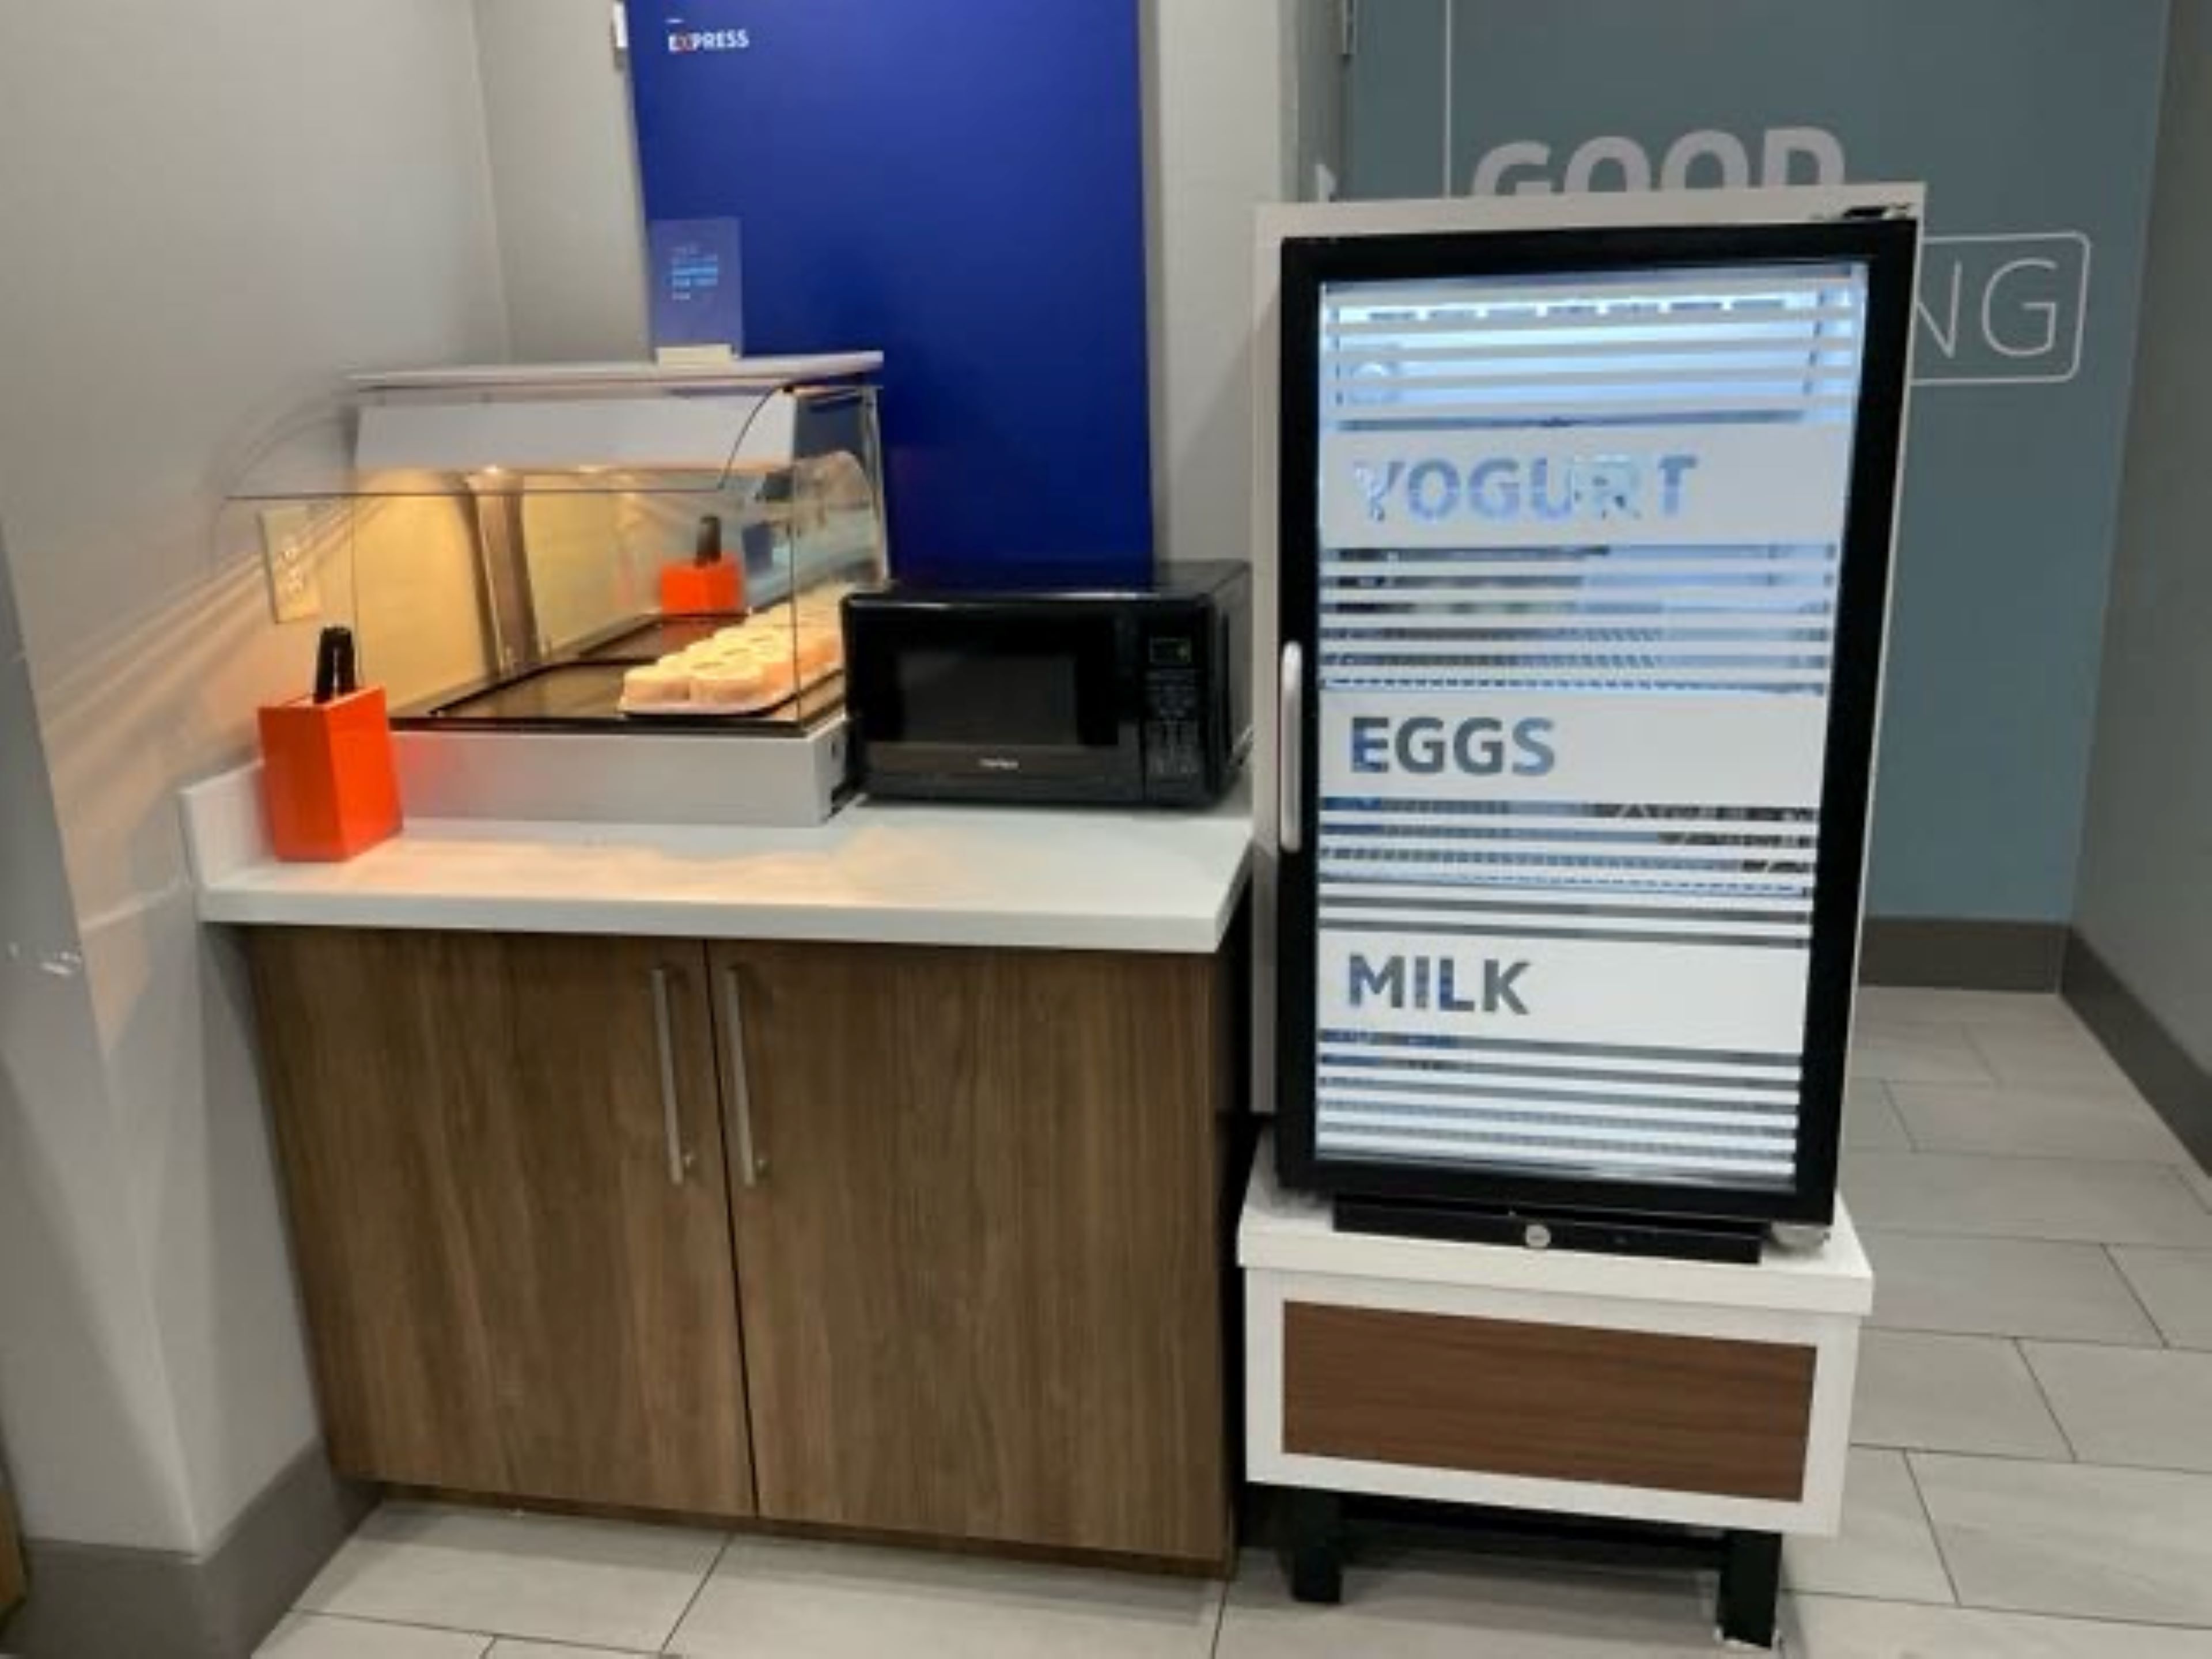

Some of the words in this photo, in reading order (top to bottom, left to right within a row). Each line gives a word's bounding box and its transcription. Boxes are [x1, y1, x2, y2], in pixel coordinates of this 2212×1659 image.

[1354, 454, 1698, 522] YOGURT
[1349, 715, 1556, 777] EGGS
[1348, 953, 1532, 1016] MILK
